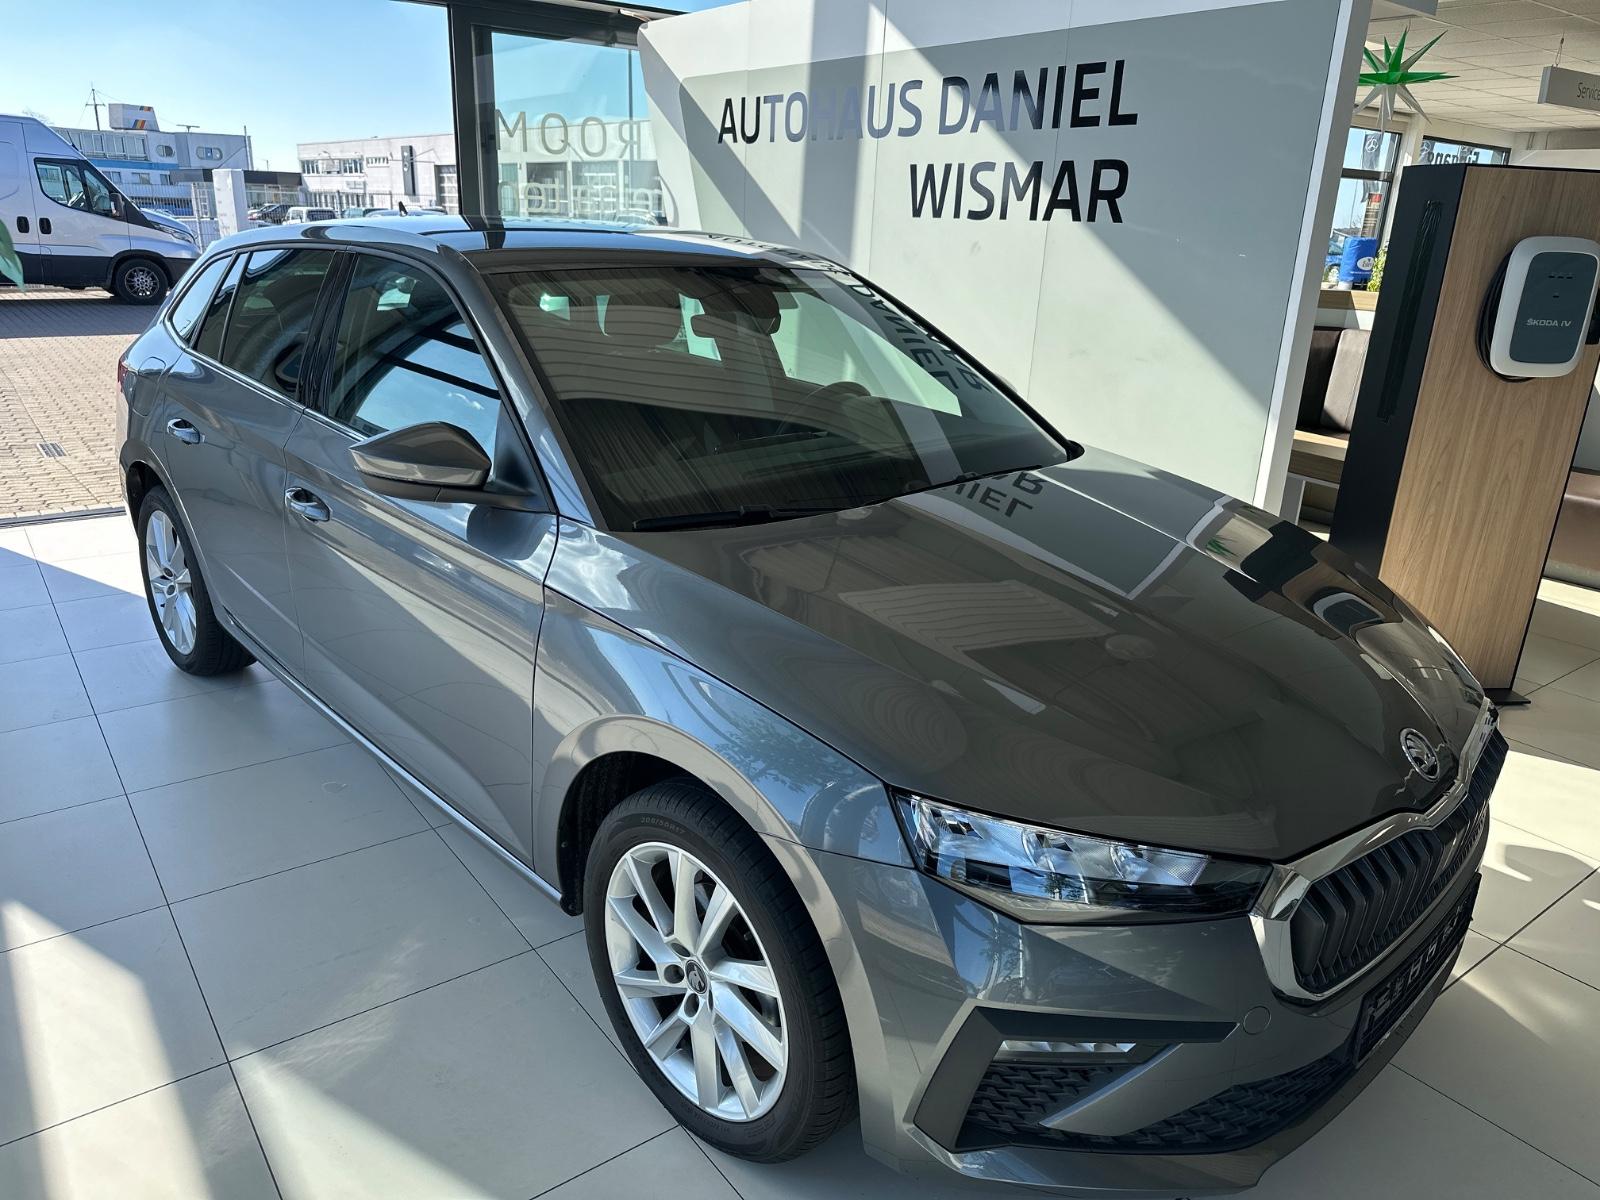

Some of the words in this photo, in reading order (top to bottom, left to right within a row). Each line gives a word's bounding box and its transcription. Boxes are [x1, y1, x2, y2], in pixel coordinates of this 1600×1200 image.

[718, 79, 924, 145] AUTOHAUS
[938, 59, 1139, 135] DANIEL
[909, 158, 1129, 223] WISMAR
[1526, 318, 1558, 327] ŠKODA
